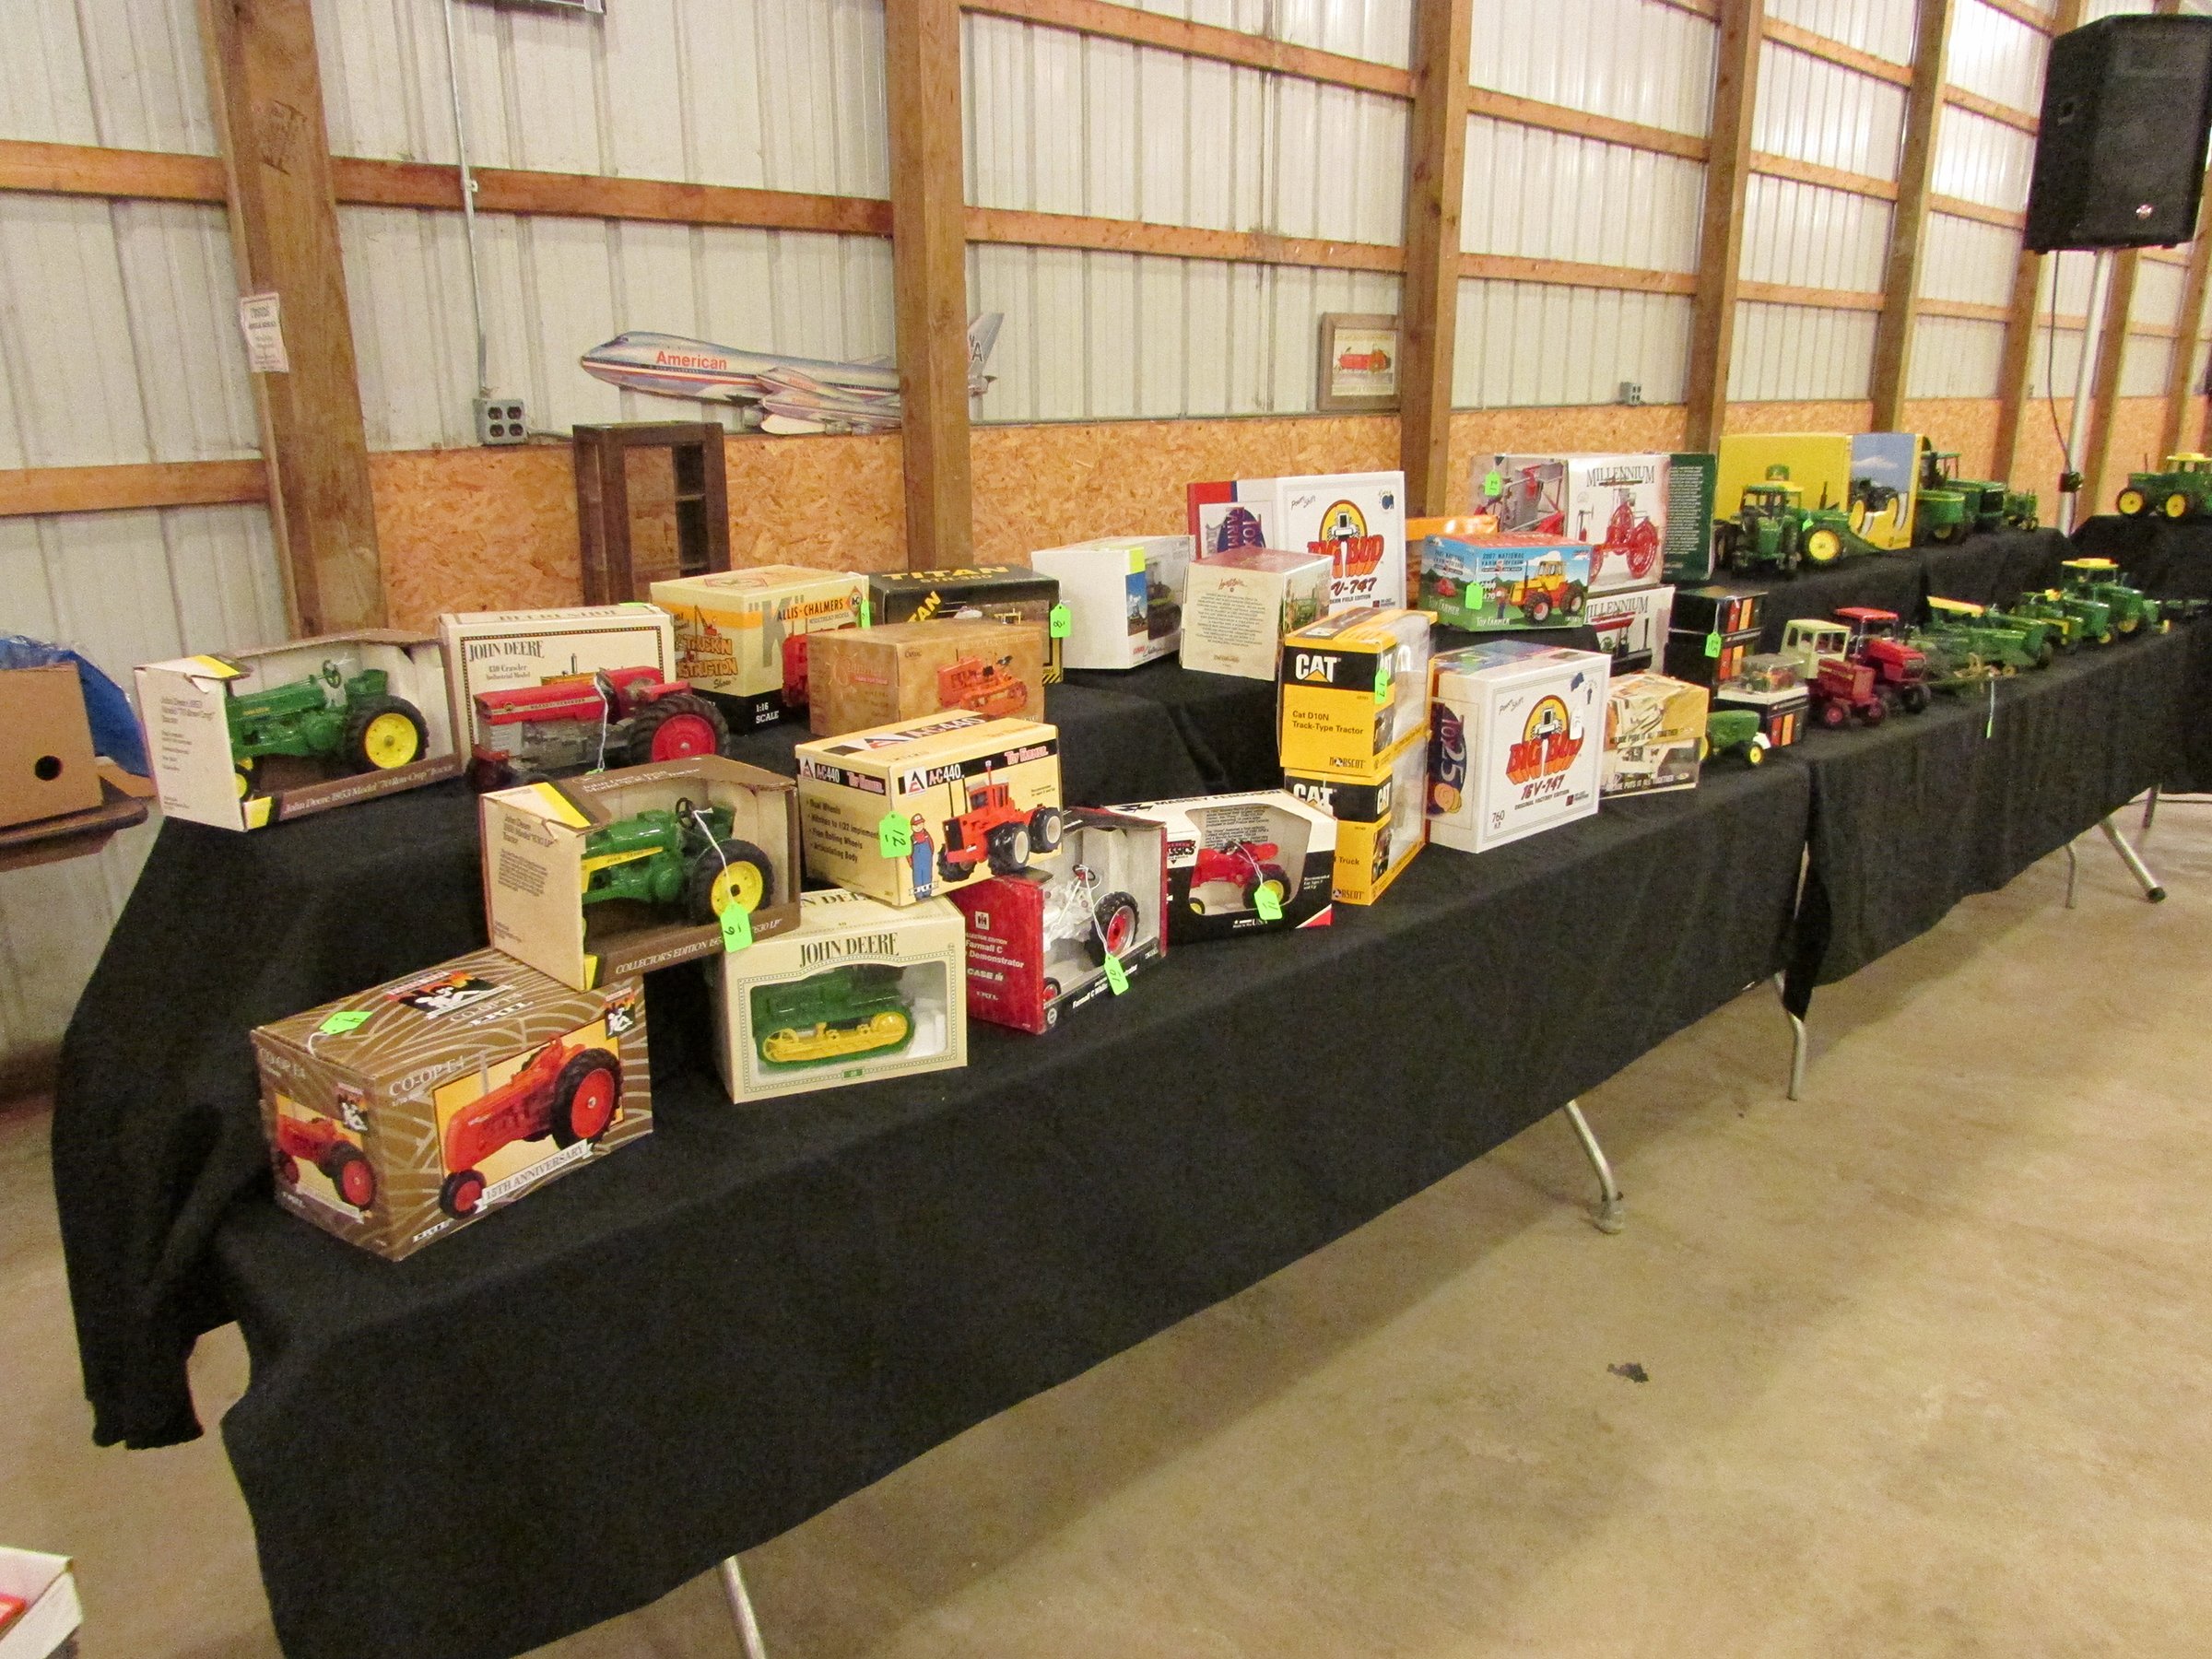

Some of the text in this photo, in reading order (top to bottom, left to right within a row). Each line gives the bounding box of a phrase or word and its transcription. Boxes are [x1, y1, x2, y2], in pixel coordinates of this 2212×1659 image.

[655, 350, 727, 371] American
[1586, 465, 1654, 488] MILLENNIUM
[1346, 535, 1384, 577] BUD
[882, 567, 1009, 581] TITAN
[1331, 577, 1377, 596] V-747
[469, 640, 545, 662] JOHN DEERE
[500, 663, 528, 672] Crawler
[513, 671, 531, 679] Model
[1295, 653, 1337, 683] CAT
[756, 702, 769, 712] 1:16
[756, 711, 779, 724] SCALE
[1292, 711, 1329, 721] Cat D10N
[1292, 721, 1363, 735] Track-Type Tractor
[1339, 764, 1359, 773] Truck
[284, 802, 305, 814] John
[306, 797, 329, 809] Deere
[1377, 782, 1391, 815] CAT
[1492, 810, 1504, 823] 760
[844, 852, 858, 864] Body
[673, 940, 707, 958] EDITION
[800, 932, 900, 968] JOHN DEERE
[966, 940, 995, 952] Farmall
[969, 950, 1025, 969] Demonstrator
[967, 968, 994, 980] CASE
[390, 1065, 442, 1096] CO-OP
[485, 1144, 584, 1200] 15TH ANNIVERSARY
